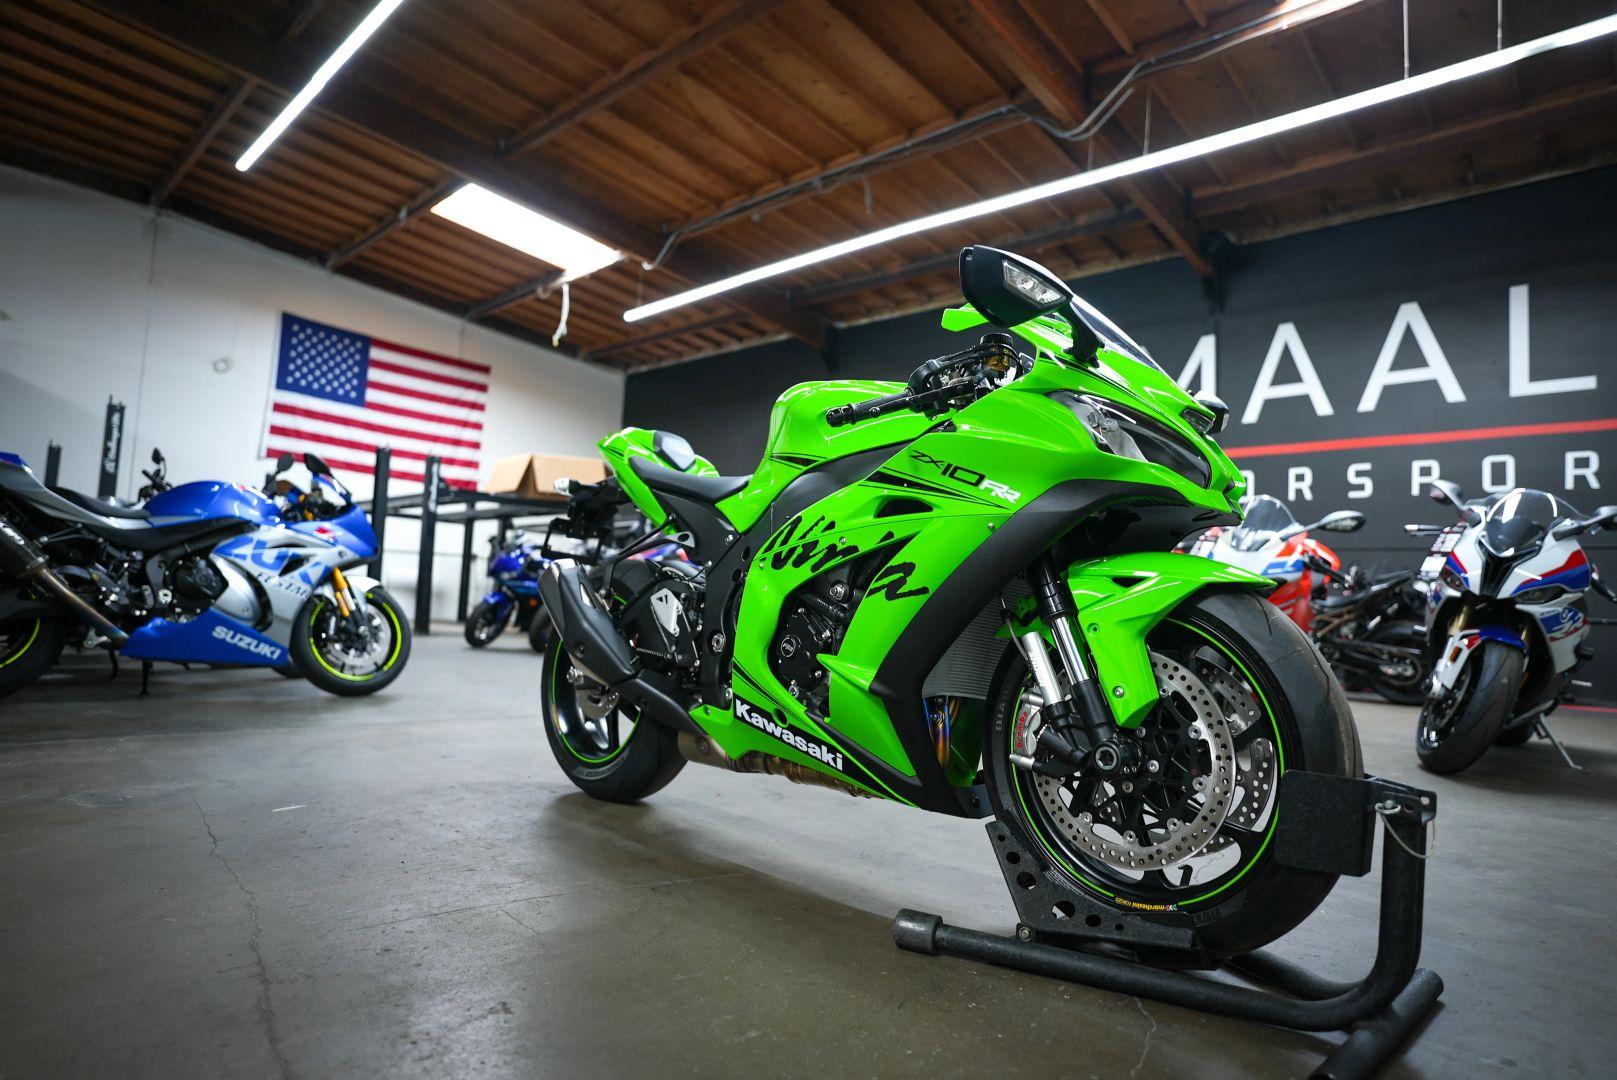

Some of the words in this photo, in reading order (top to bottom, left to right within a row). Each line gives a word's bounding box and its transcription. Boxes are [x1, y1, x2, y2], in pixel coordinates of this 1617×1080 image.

[759, 515, 930, 601] Nina
[212, 625, 282, 660] SUZUKI
[735, 698, 843, 771] Kawasaki
